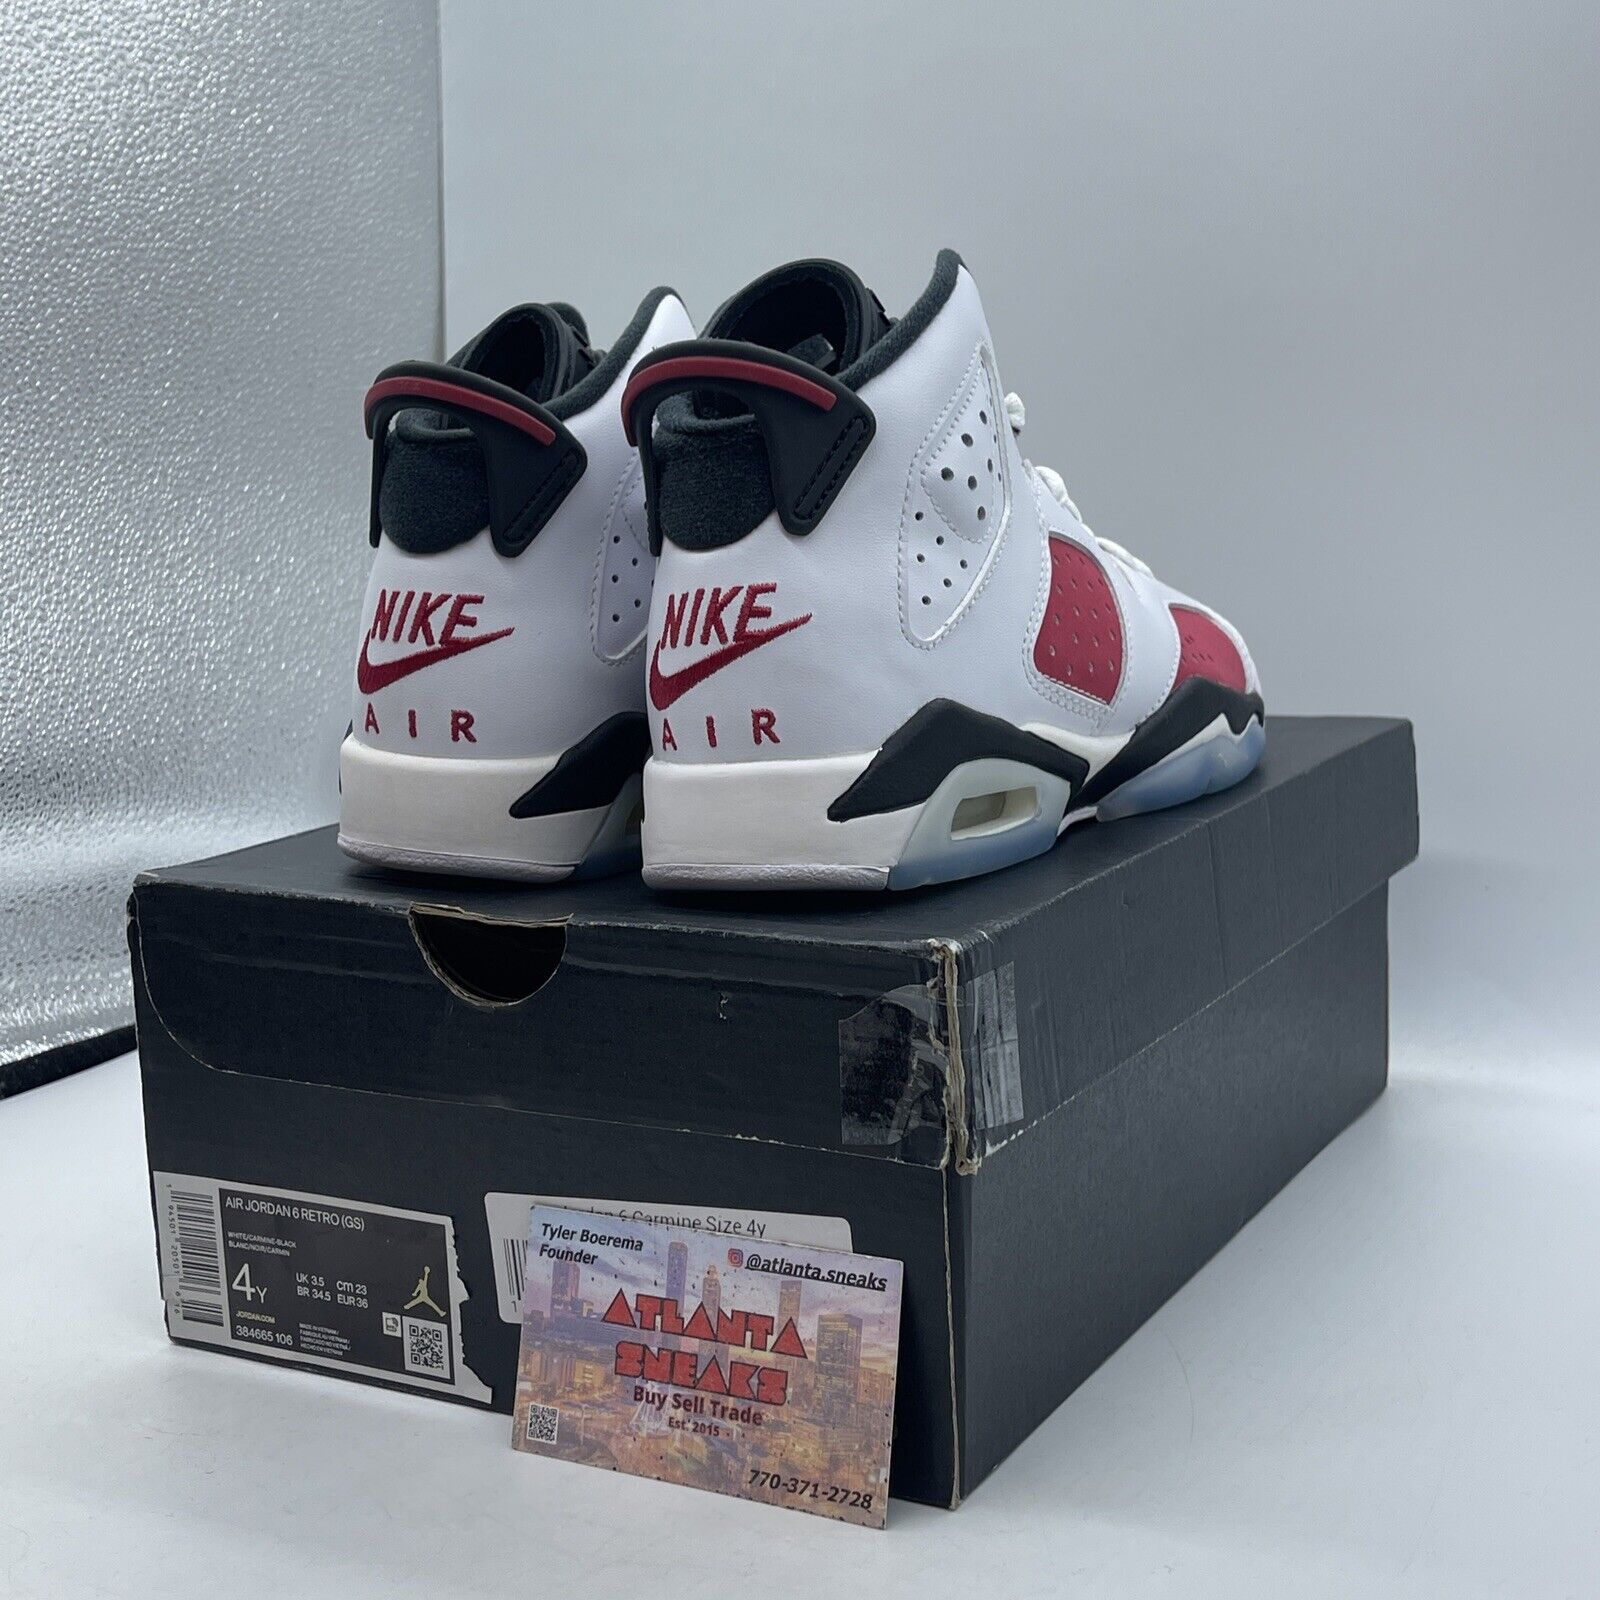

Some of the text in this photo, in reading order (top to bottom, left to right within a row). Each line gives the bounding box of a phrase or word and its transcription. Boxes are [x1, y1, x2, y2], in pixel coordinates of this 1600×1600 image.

[371, 588, 485, 646] NIKE
[661, 582, 777, 650] NIKE
[364, 702, 477, 743] AIR
[661, 707, 781, 751] AIR
[225, 1197, 365, 1231] AIR JORDAN 6 RETRO (GS)
[706, 1215, 742, 1235] Size
[747, 1219, 767, 1238] 4y
[539, 1244, 598, 1266] Founder
[541, 1223, 644, 1252] Tyler Boerema
[232, 1263, 267, 1303] 4Y
[296, 1273, 325, 1287] UK 3.5
[355, 1284, 367, 1296] 23
[745, 1253, 888, 1292] @atlanta.sneaks
[297, 1286, 331, 1301] BR 34.5
[337, 1294, 368, 1309] EUR 36
[236, 1325, 273, 1342] 384665
[275, 1333, 293, 1346] 106
[602, 1288, 807, 1359] ATLANTA
[615, 1340, 789, 1406] SNEAKS
[634, 1386, 764, 1426] Buy Sell Trade
[692, 1420, 720, 1437] 2015
[748, 1469, 873, 1510] 770-371-2728
